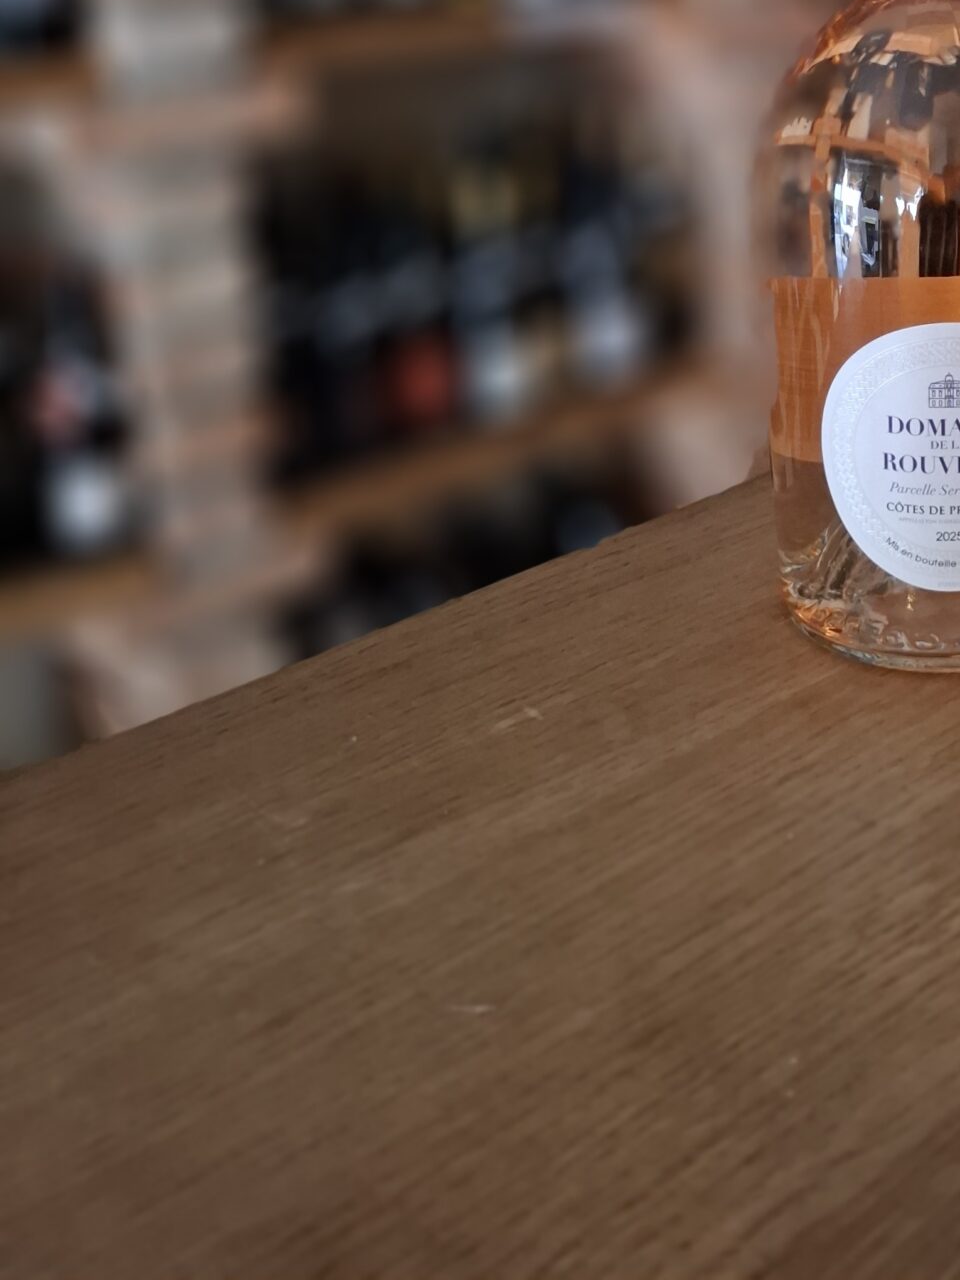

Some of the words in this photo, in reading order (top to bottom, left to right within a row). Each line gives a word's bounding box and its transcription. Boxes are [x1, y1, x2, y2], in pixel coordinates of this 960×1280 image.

[930, 440, 948, 450] DE
[889, 481, 936, 496] Parcelle
[886, 500, 925, 515] CÔTES
[929, 505, 946, 516] DE
[885, 537, 899, 552] Mis
[900, 549, 913, 559] en
[915, 554, 957, 568] bouteille
